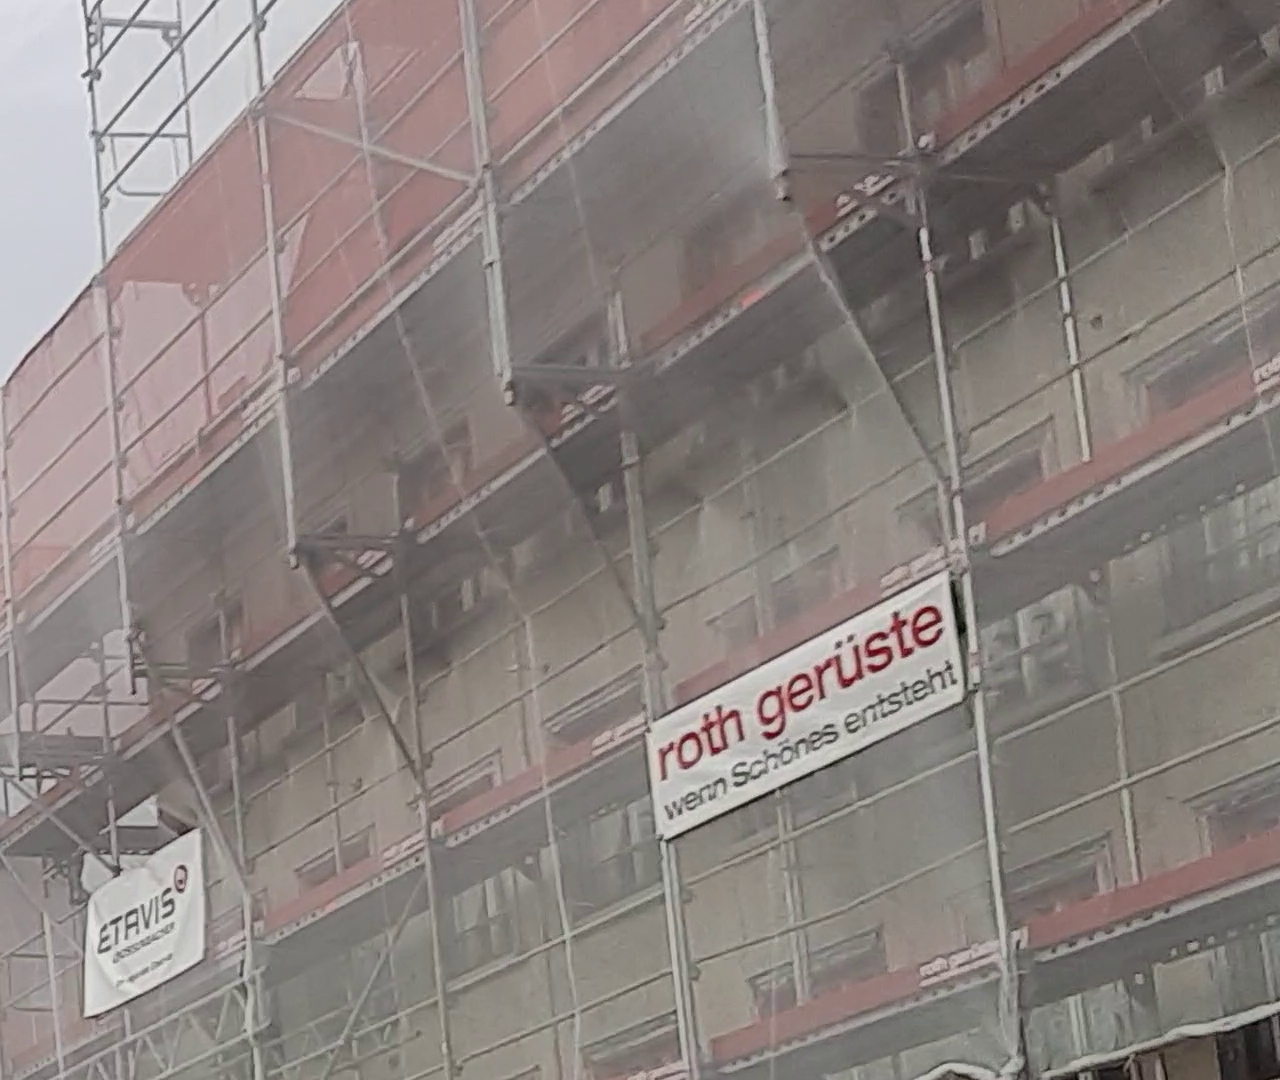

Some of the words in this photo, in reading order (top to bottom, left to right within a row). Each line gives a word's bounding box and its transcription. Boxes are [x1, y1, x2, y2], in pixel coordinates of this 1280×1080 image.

[656, 704, 744, 782] roth
[757, 603, 945, 741] gerüste
[662, 776, 728, 821] wenn
[732, 722, 839, 788] Schönes
[844, 660, 958, 735] entsteht
[97, 887, 176, 954] ETAVIS
